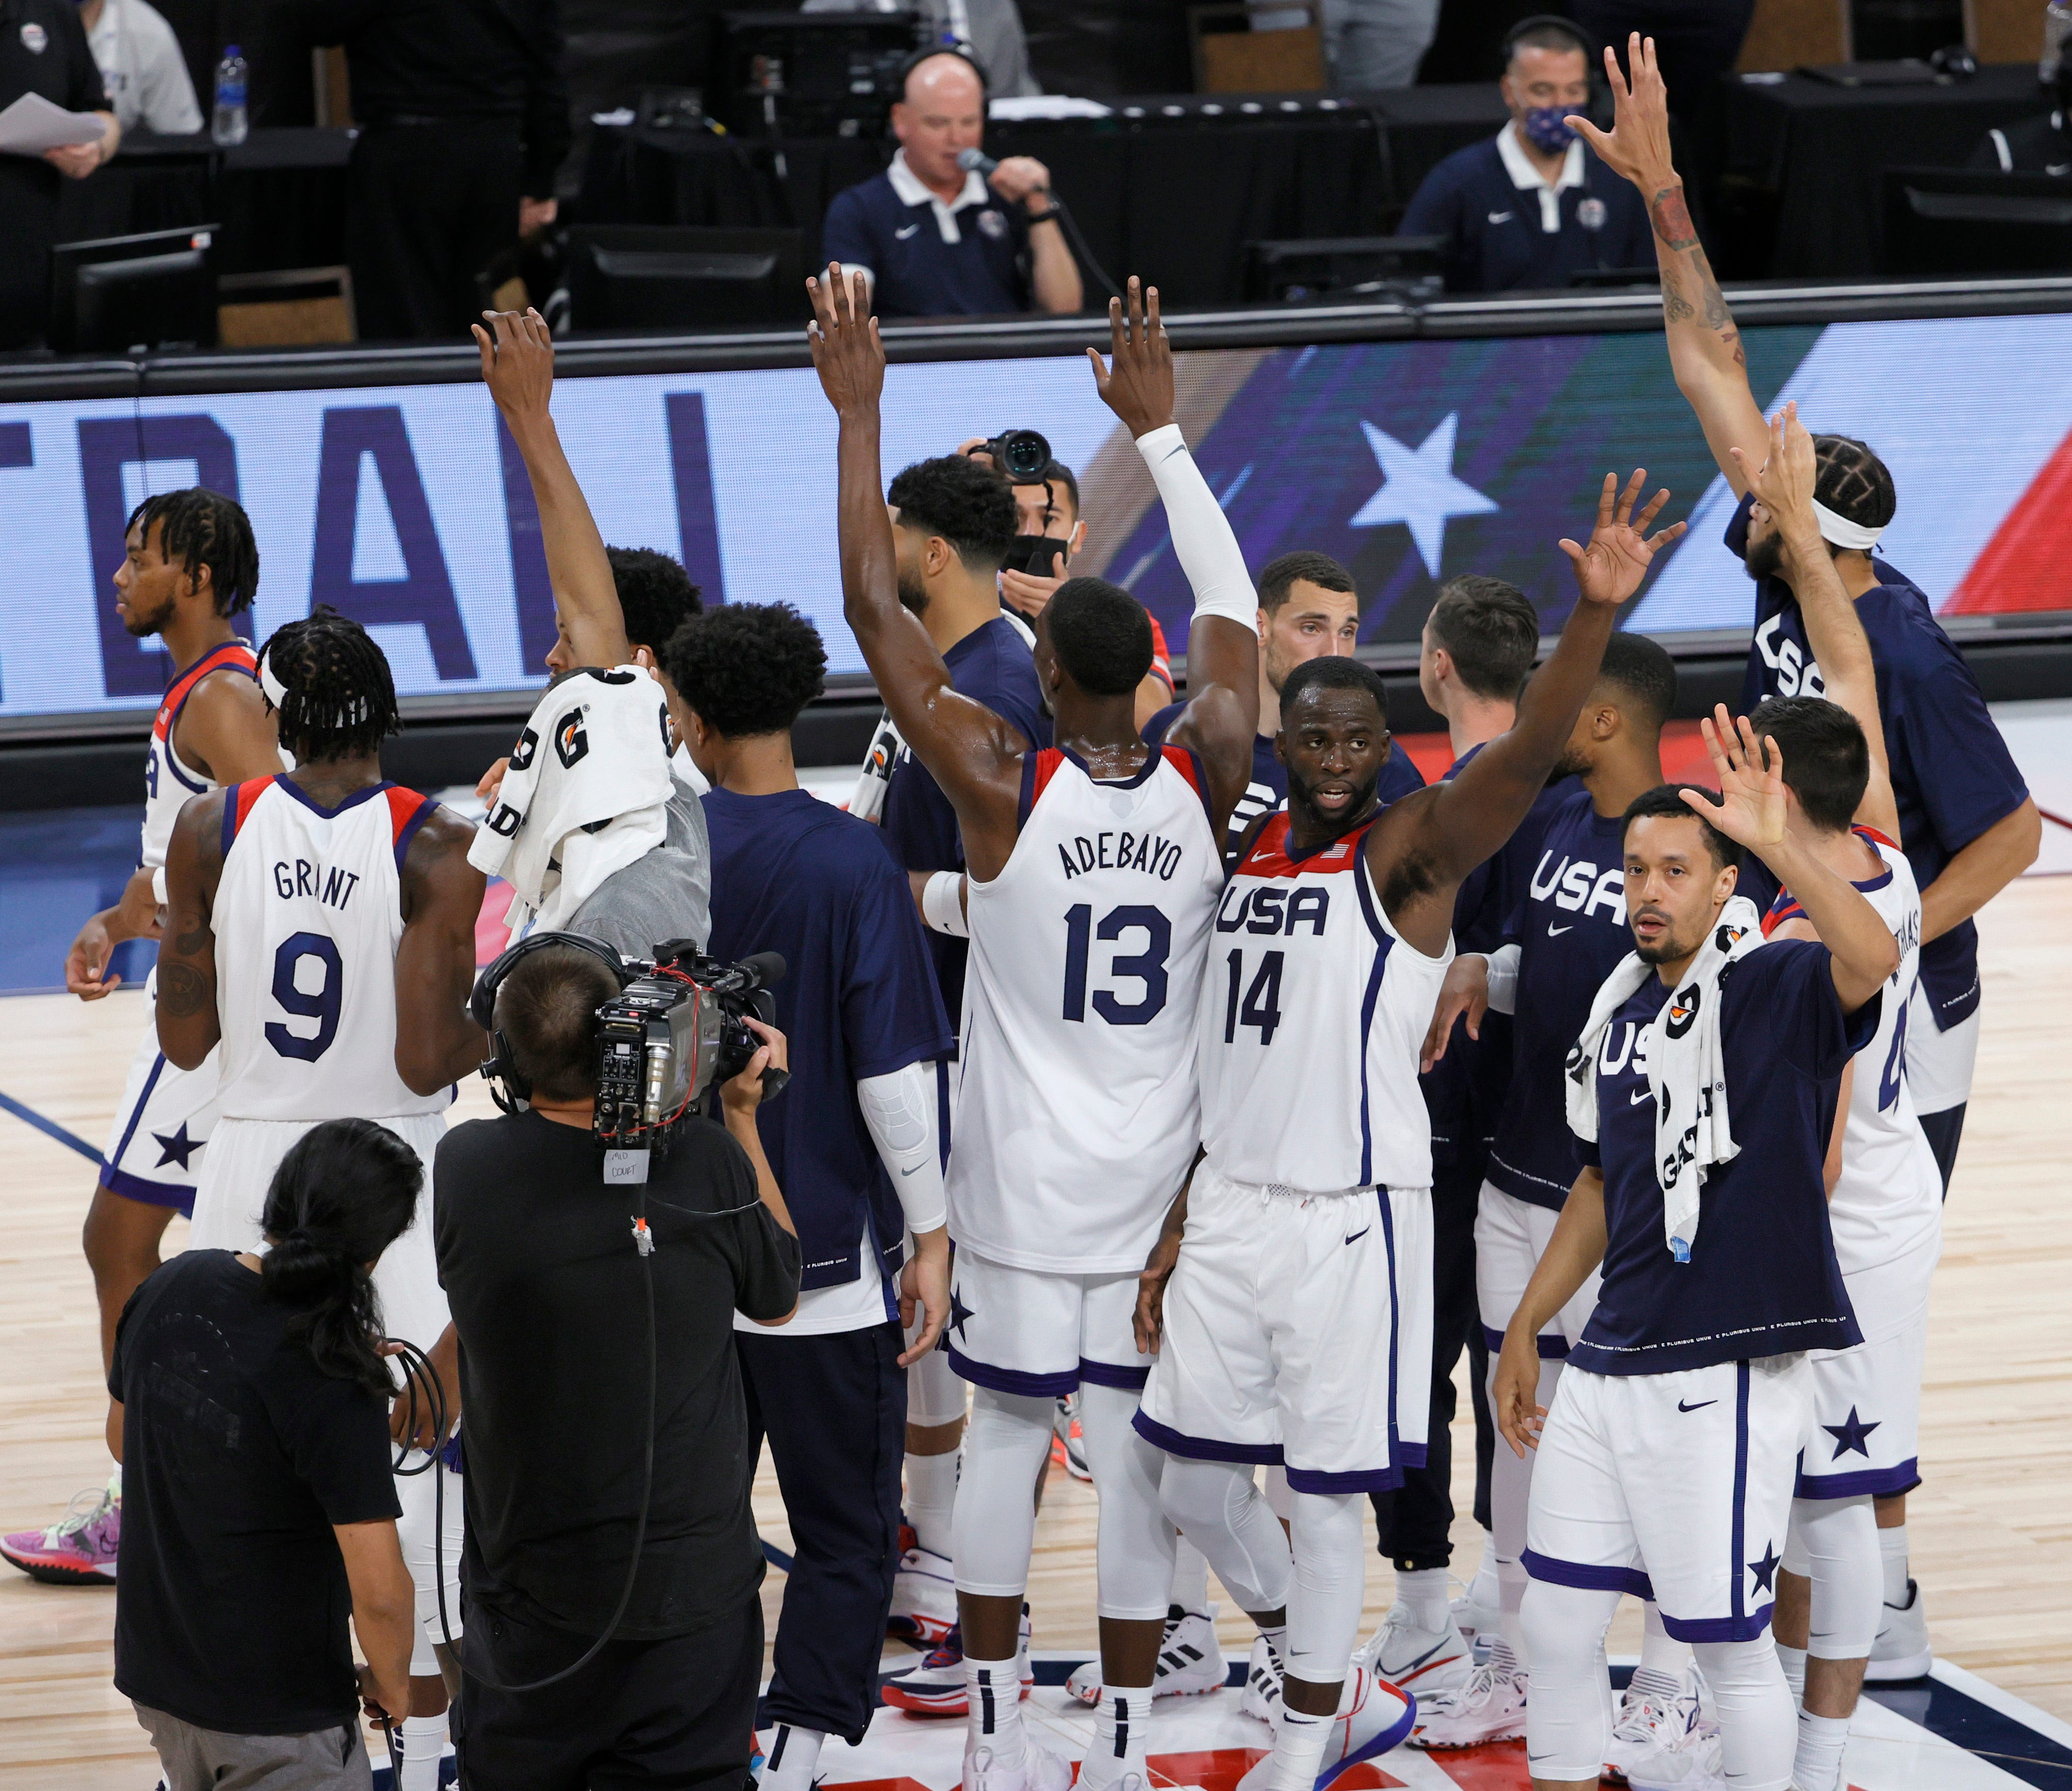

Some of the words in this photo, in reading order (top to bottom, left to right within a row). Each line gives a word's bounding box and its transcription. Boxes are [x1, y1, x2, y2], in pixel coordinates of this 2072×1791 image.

[1058, 832, 1182, 880] ADEBAYO
[274, 859, 360, 911] GRANT
[1530, 848, 1628, 927] USA
[1216, 886, 1330, 936] USA
[1063, 903, 1172, 1026] 13
[264, 931, 343, 1063] 9
[1224, 948, 1285, 1046] 14
[612, 1152, 629, 1161] MID
[612, 1164, 637, 1178] COURT
[1667, 1338, 1695, 1346] PLURIBUS
[1722, 1328, 1750, 1337] PLURIBUS
